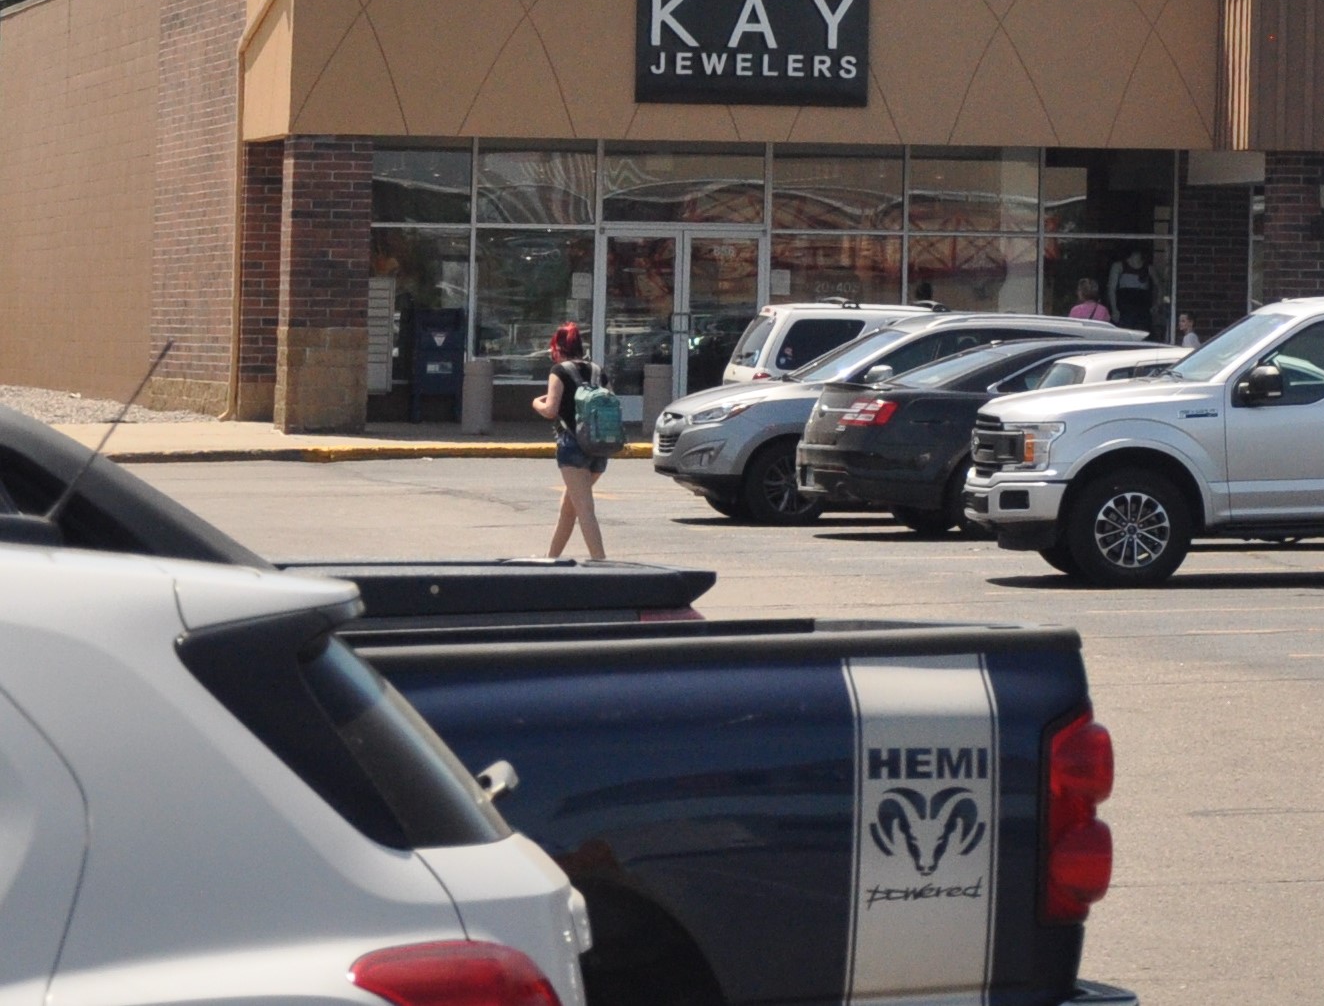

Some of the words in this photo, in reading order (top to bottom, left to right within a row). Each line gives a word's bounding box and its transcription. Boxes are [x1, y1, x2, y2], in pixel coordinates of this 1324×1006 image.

[650, 51, 858, 79] JEWELERS
[868, 747, 988, 780] HEMI
[866, 876, 983, 911] powered
